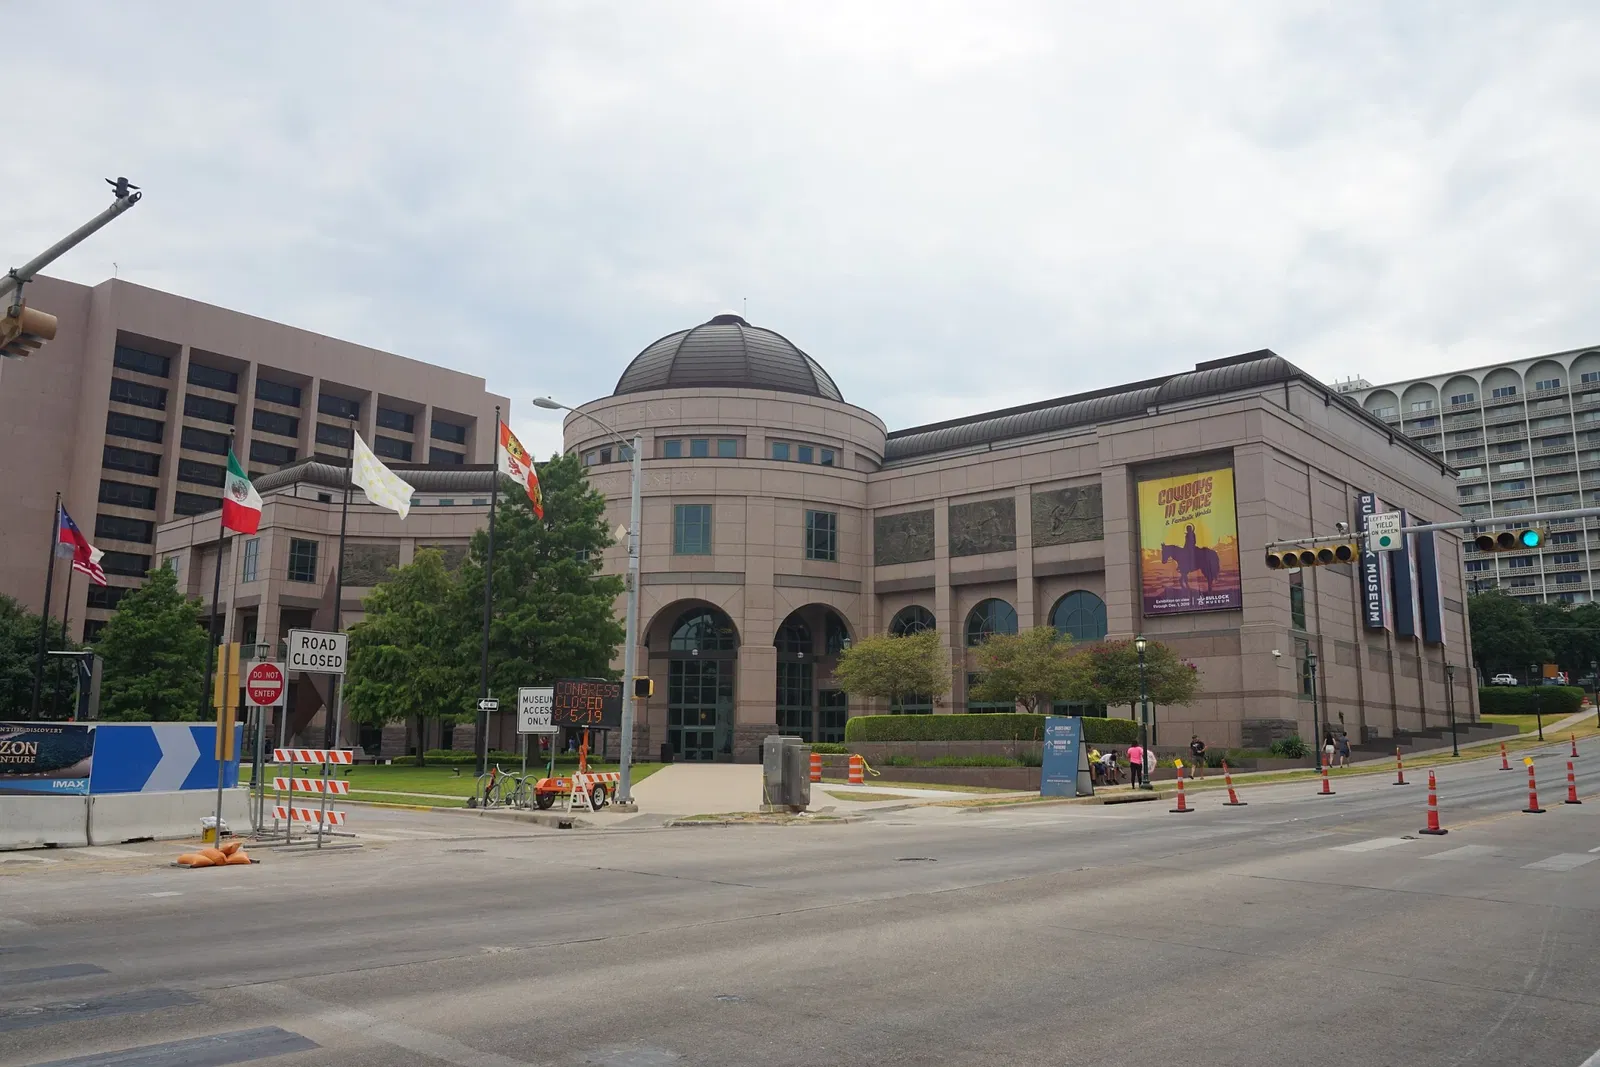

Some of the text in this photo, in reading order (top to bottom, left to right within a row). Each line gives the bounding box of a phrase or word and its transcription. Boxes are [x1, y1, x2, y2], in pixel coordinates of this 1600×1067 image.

[1158, 476, 1213, 506] COWBOYS
[1165, 492, 1212, 519] IN SPACE
[1369, 515, 1383, 523] LEFT
[1375, 521, 1394, 529] YIELD
[1361, 495, 1380, 622] BULLK MUSEUM
[302, 636, 337, 651] ROAD
[293, 653, 343, 668] CLOSED
[253, 671, 279, 679] DO NOT
[556, 681, 620, 698] CONGRESS
[523, 705, 553, 714] ACCESS
[555, 695, 603, 710] CLOSED
[527, 717, 548, 725] ONLY
[554, 709, 602, 724] 8/5/19
[0, 740, 39, 755] ZON
[0, 755, 36, 764] NTURE
[52, 780, 85, 788] IMAX
